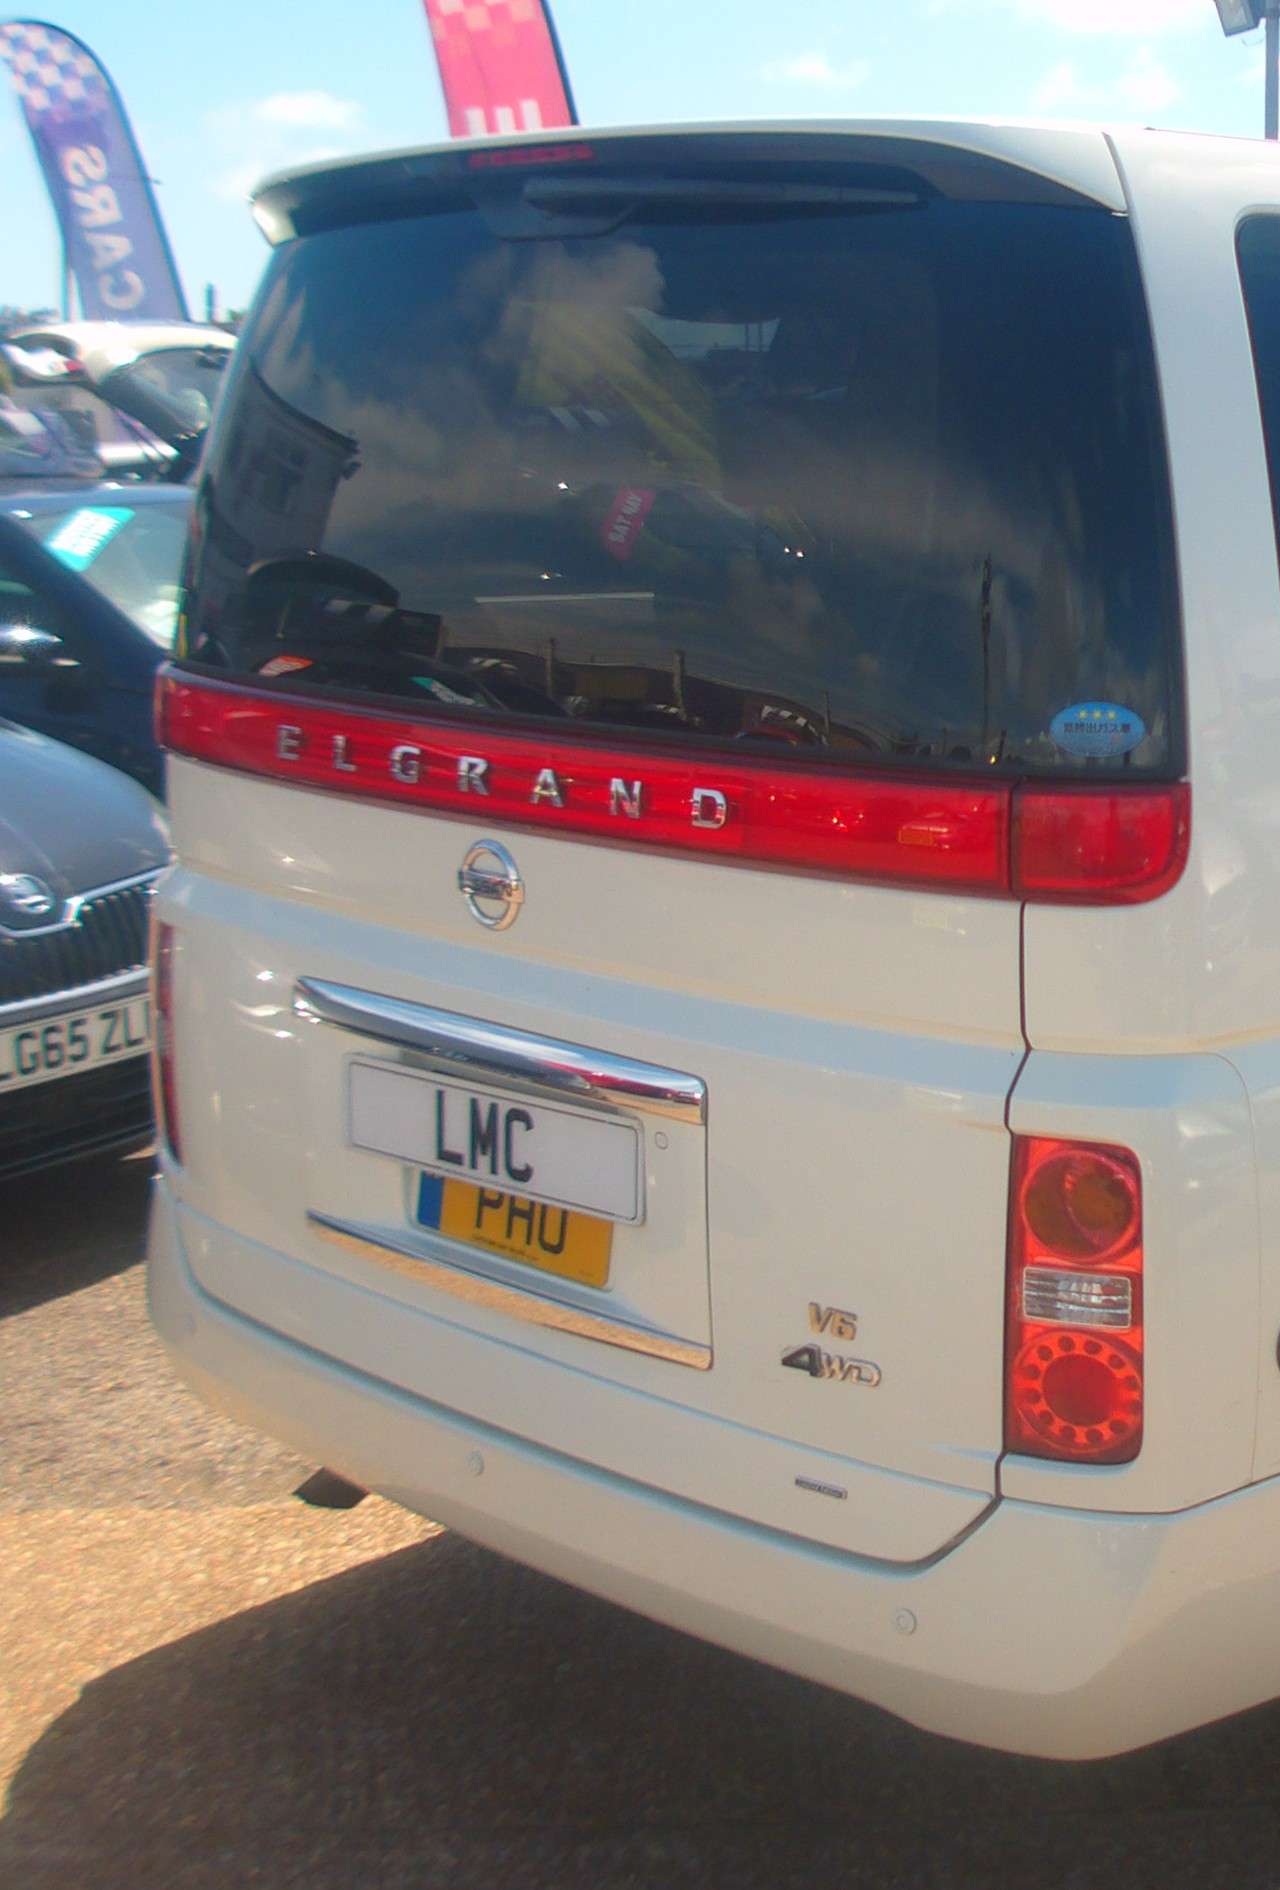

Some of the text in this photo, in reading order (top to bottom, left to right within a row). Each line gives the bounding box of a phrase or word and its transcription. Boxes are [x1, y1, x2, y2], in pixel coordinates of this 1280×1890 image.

[276, 724, 728, 830] ELGRAND
[435, 1088, 535, 1184] LMC
[807, 1301, 858, 1341] V6
[780, 1343, 882, 1388] 4WD
